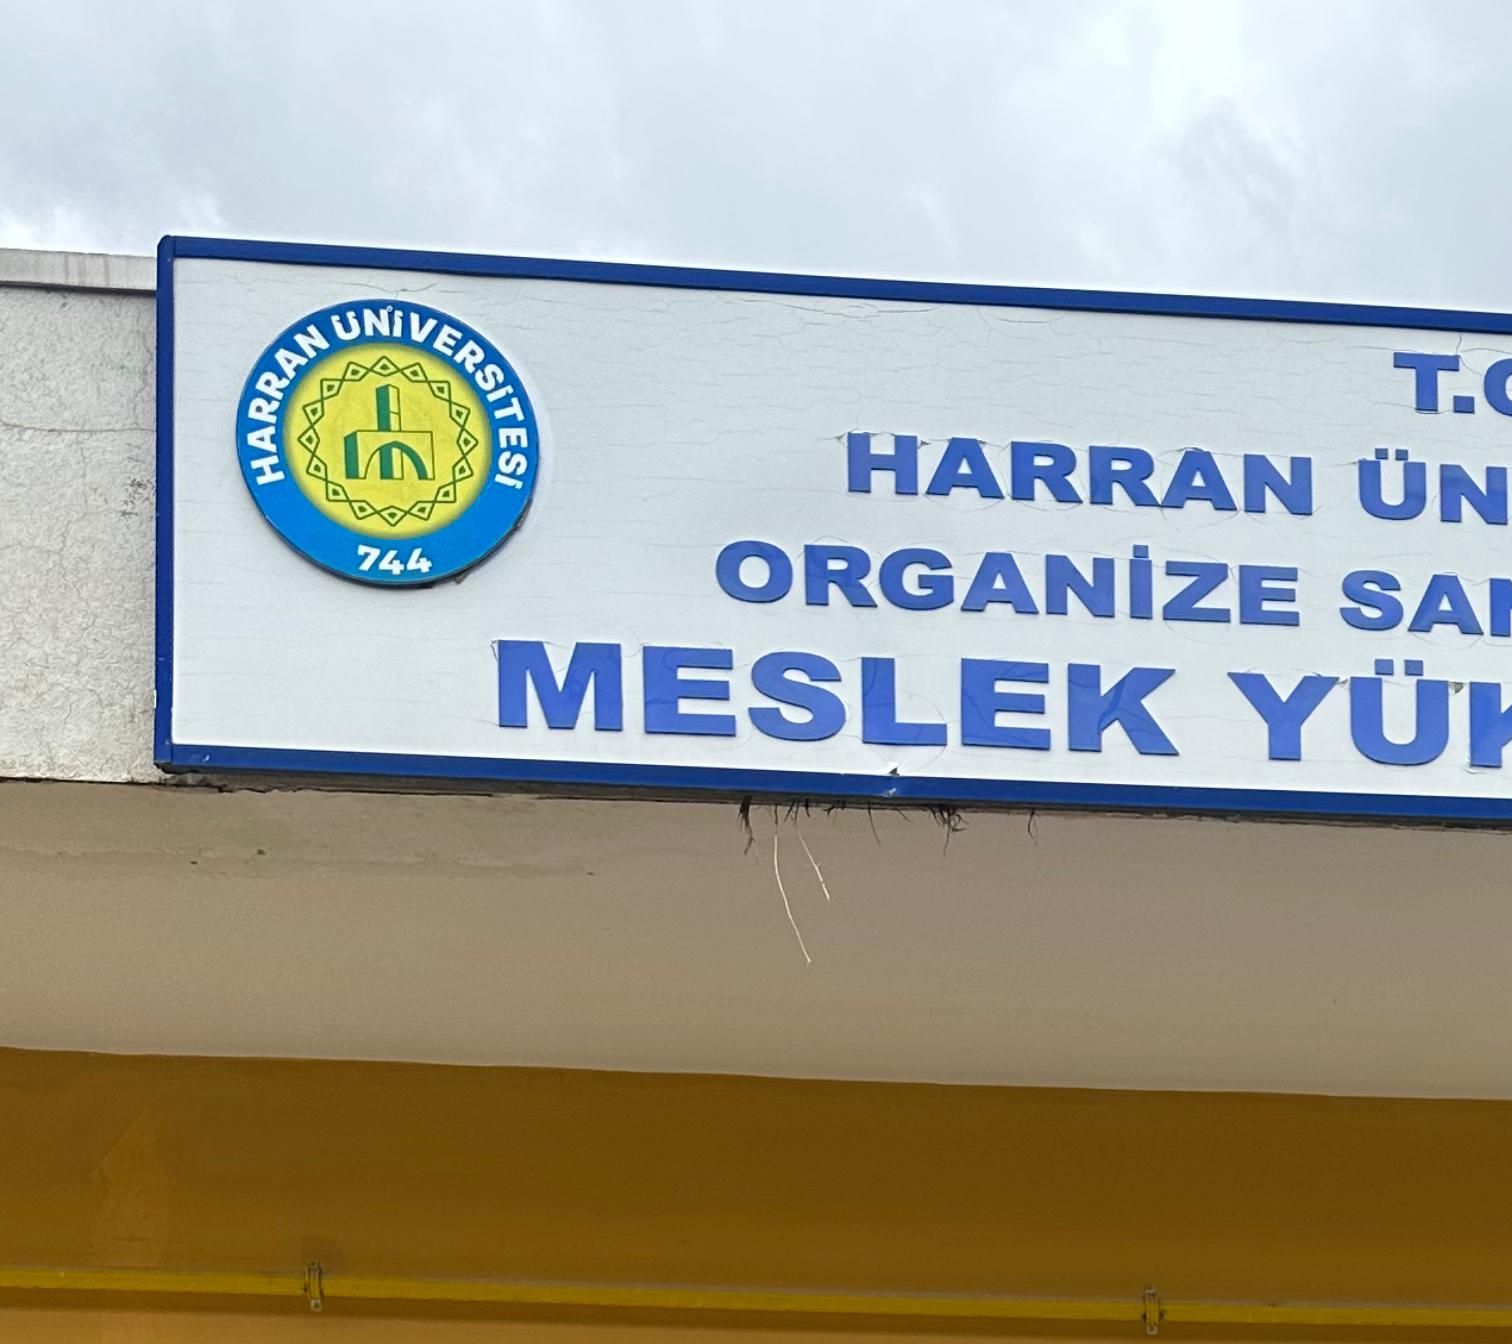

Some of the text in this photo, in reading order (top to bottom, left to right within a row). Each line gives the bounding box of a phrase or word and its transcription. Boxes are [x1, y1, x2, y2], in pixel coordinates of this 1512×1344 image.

[247, 325, 330, 485] HARRAN
[847, 432, 1313, 516] HARRAN
[357, 545, 432, 575] 744
[715, 540, 1300, 627] ORGANİZE
[497, 640, 1176, 756] MESLEK
